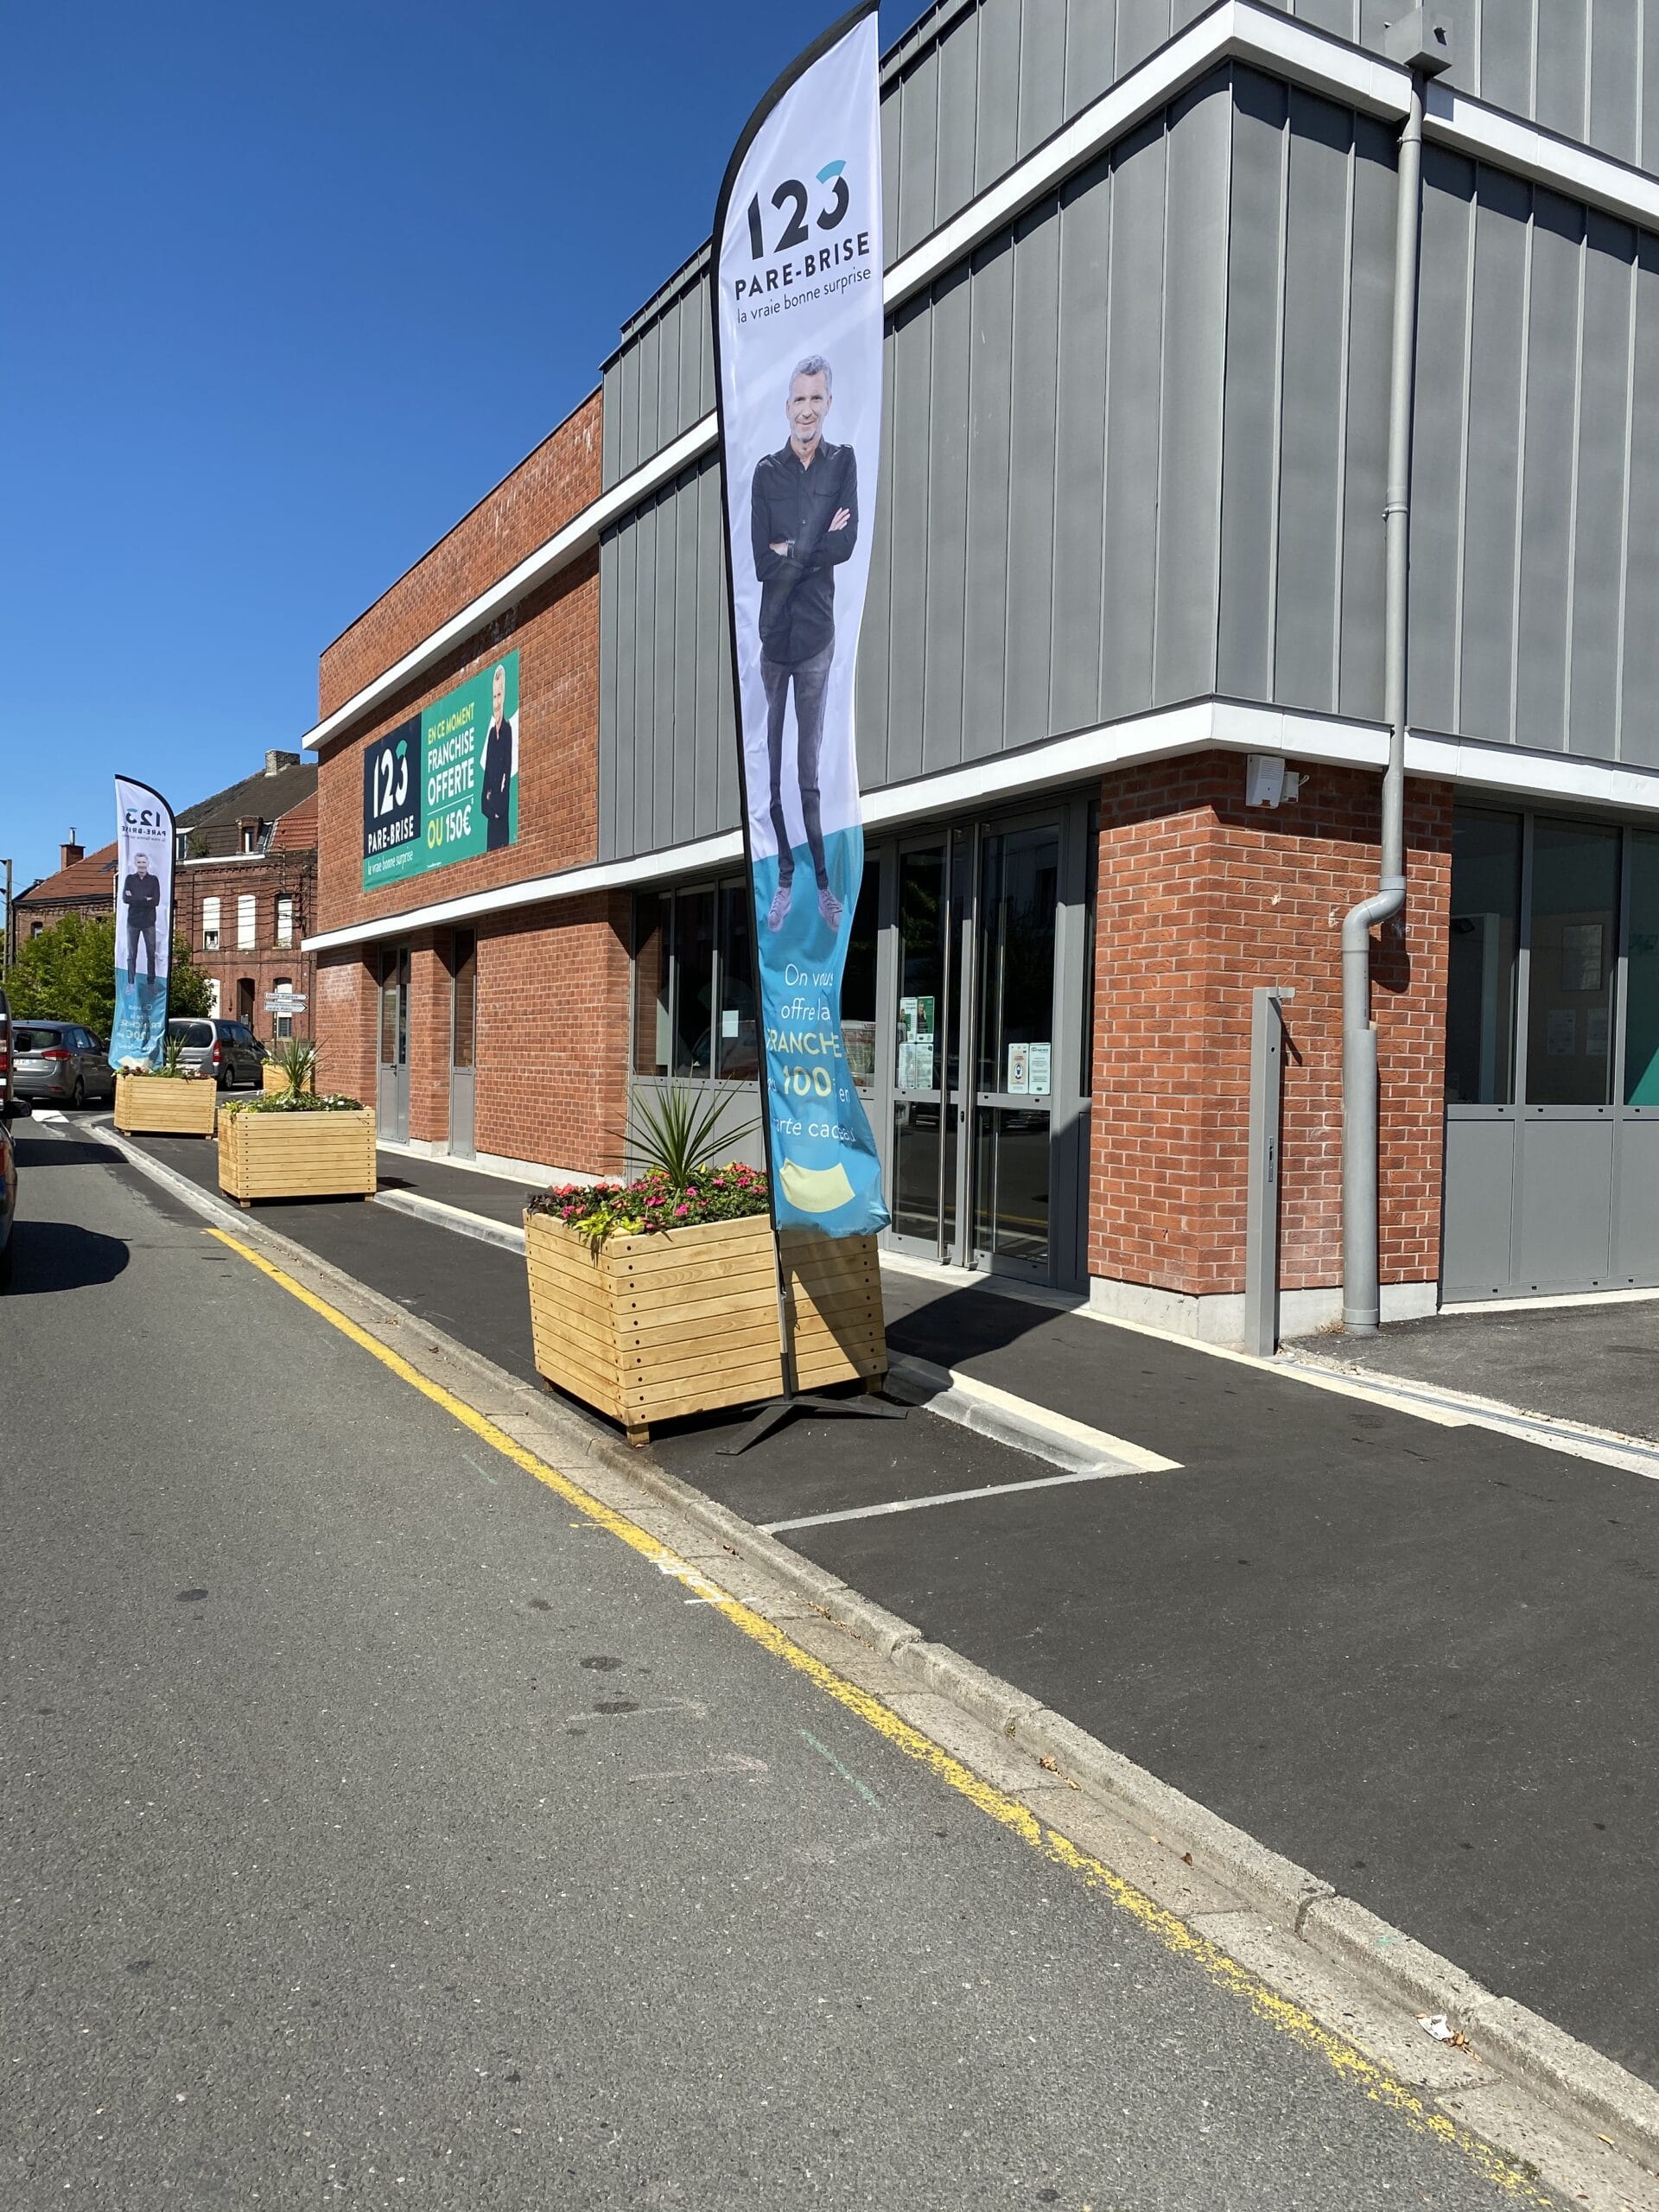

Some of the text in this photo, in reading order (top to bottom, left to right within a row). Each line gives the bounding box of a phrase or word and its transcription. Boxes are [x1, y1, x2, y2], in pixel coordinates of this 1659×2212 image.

[747, 159, 849, 260] 123
[734, 231, 870, 301] PARE-BRISE
[737, 266, 871, 323] la vraie bonne surprise
[446, 701, 474, 735] MOMENT
[428, 727, 474, 773] FRANCHISE
[373, 740, 408, 818] 123
[428, 757, 474, 806] OFFERTE
[368, 814, 414, 854] PARE-BRISE
[428, 804, 472, 849] OU 150€
[785, 963, 834, 987] On vous
[781, 997, 831, 1020] offre la
